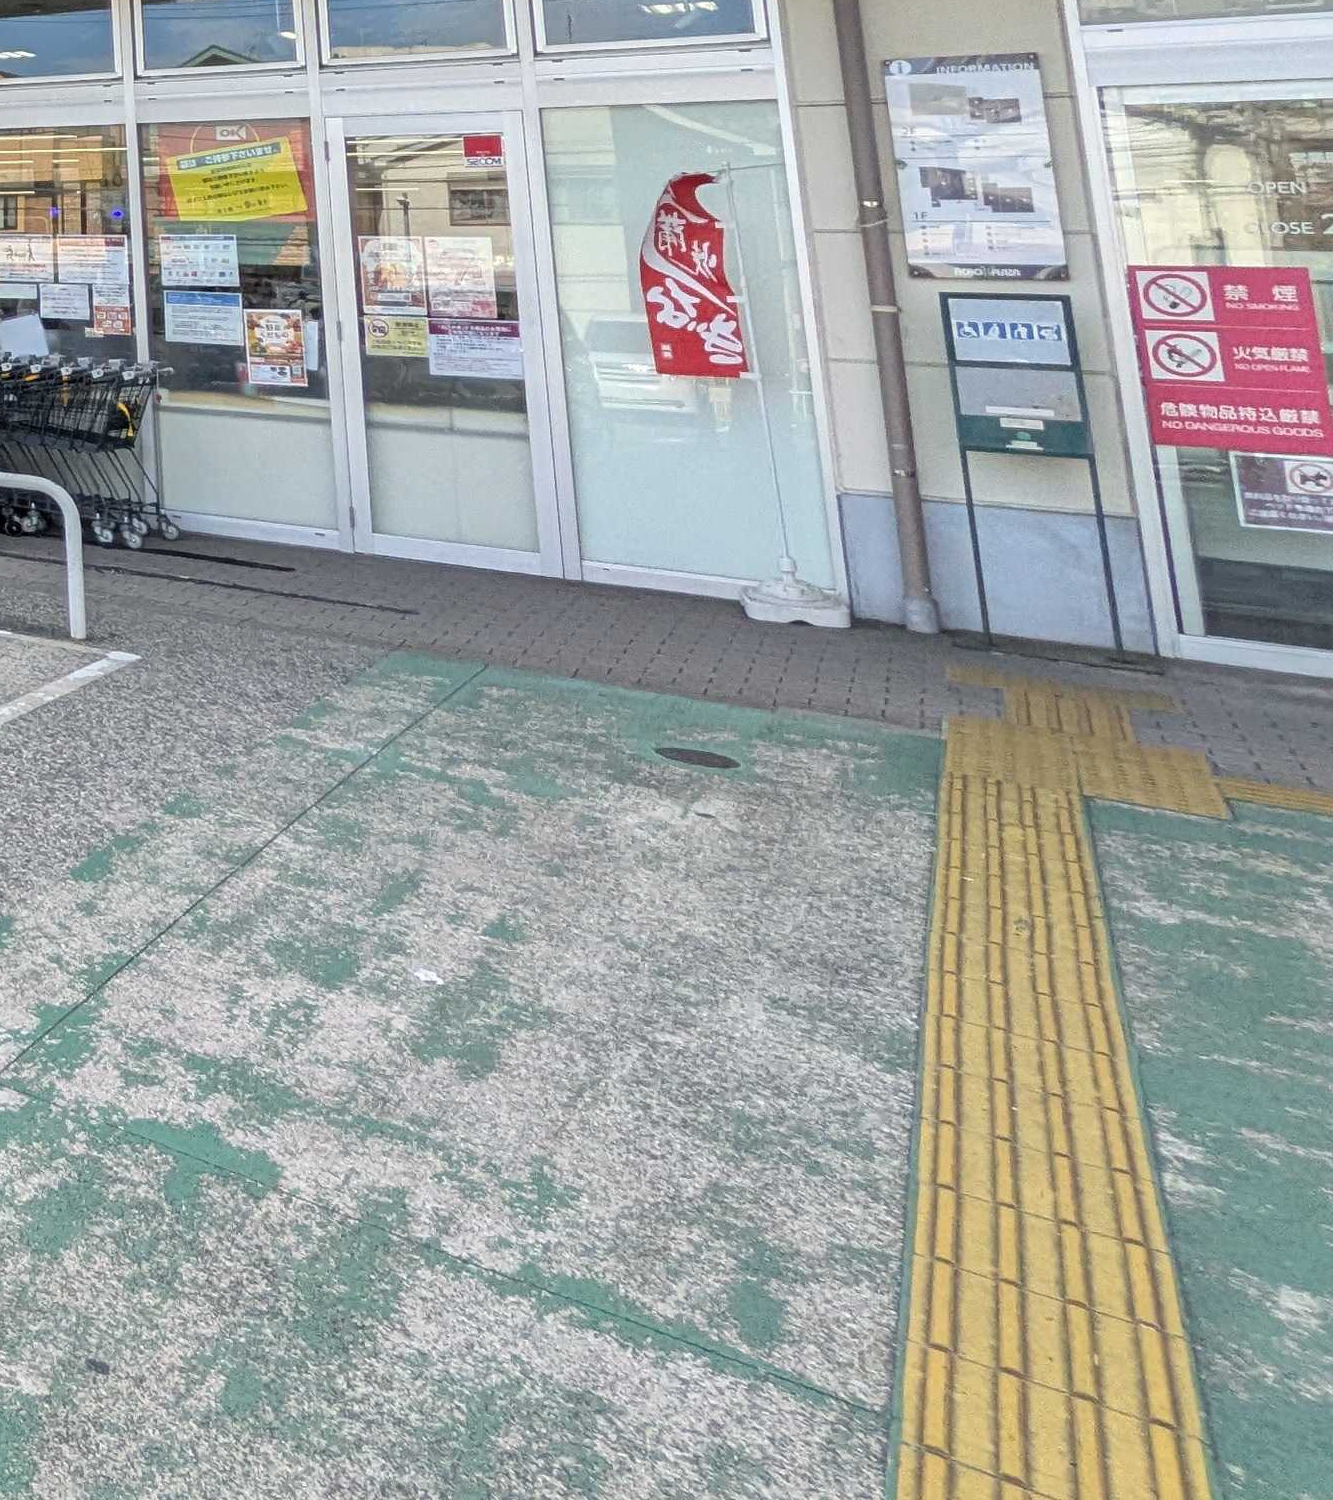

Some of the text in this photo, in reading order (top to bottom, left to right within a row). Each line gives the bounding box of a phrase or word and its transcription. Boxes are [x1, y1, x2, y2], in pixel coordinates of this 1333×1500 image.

[935, 62, 1035, 75] INFORMATION
[219, 126, 246, 140] OK
[466, 157, 502, 166] SECOM
[1247, 181, 1307, 194] OPEN
[1225, 302, 1300, 311] NO SMOKING
[1233, 346, 1309, 362] 火気厳禁
[1162, 420, 1324, 438] NO DANGEROUS GOODS
